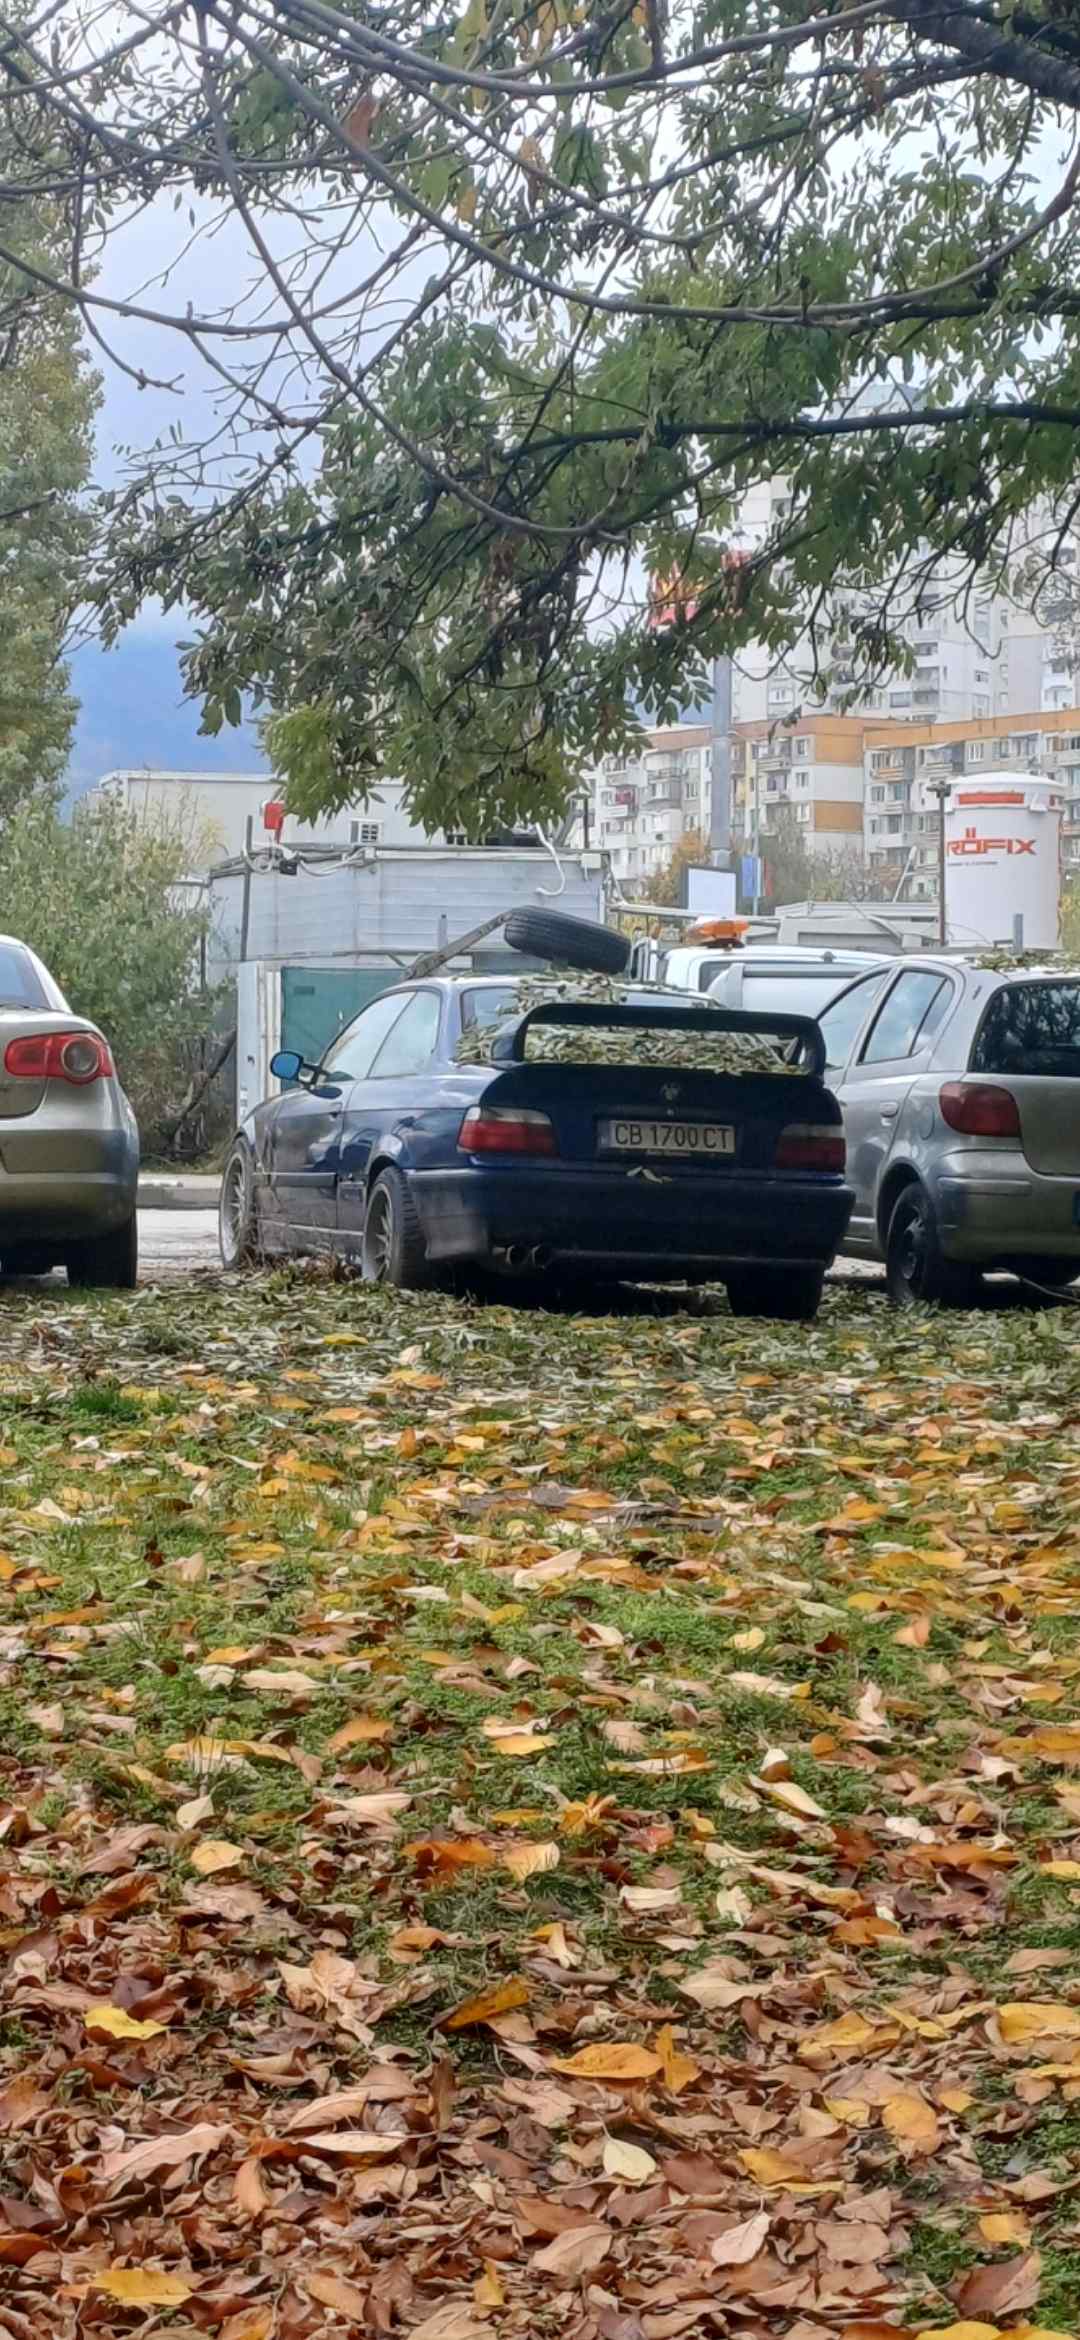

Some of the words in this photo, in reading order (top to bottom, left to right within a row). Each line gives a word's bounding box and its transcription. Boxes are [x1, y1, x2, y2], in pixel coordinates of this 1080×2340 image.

[947, 826, 1036, 855] RÖFIX
[615, 1123, 642, 1145] CB
[650, 1125, 698, 1148] 1700
[703, 1128, 729, 1149] CT
